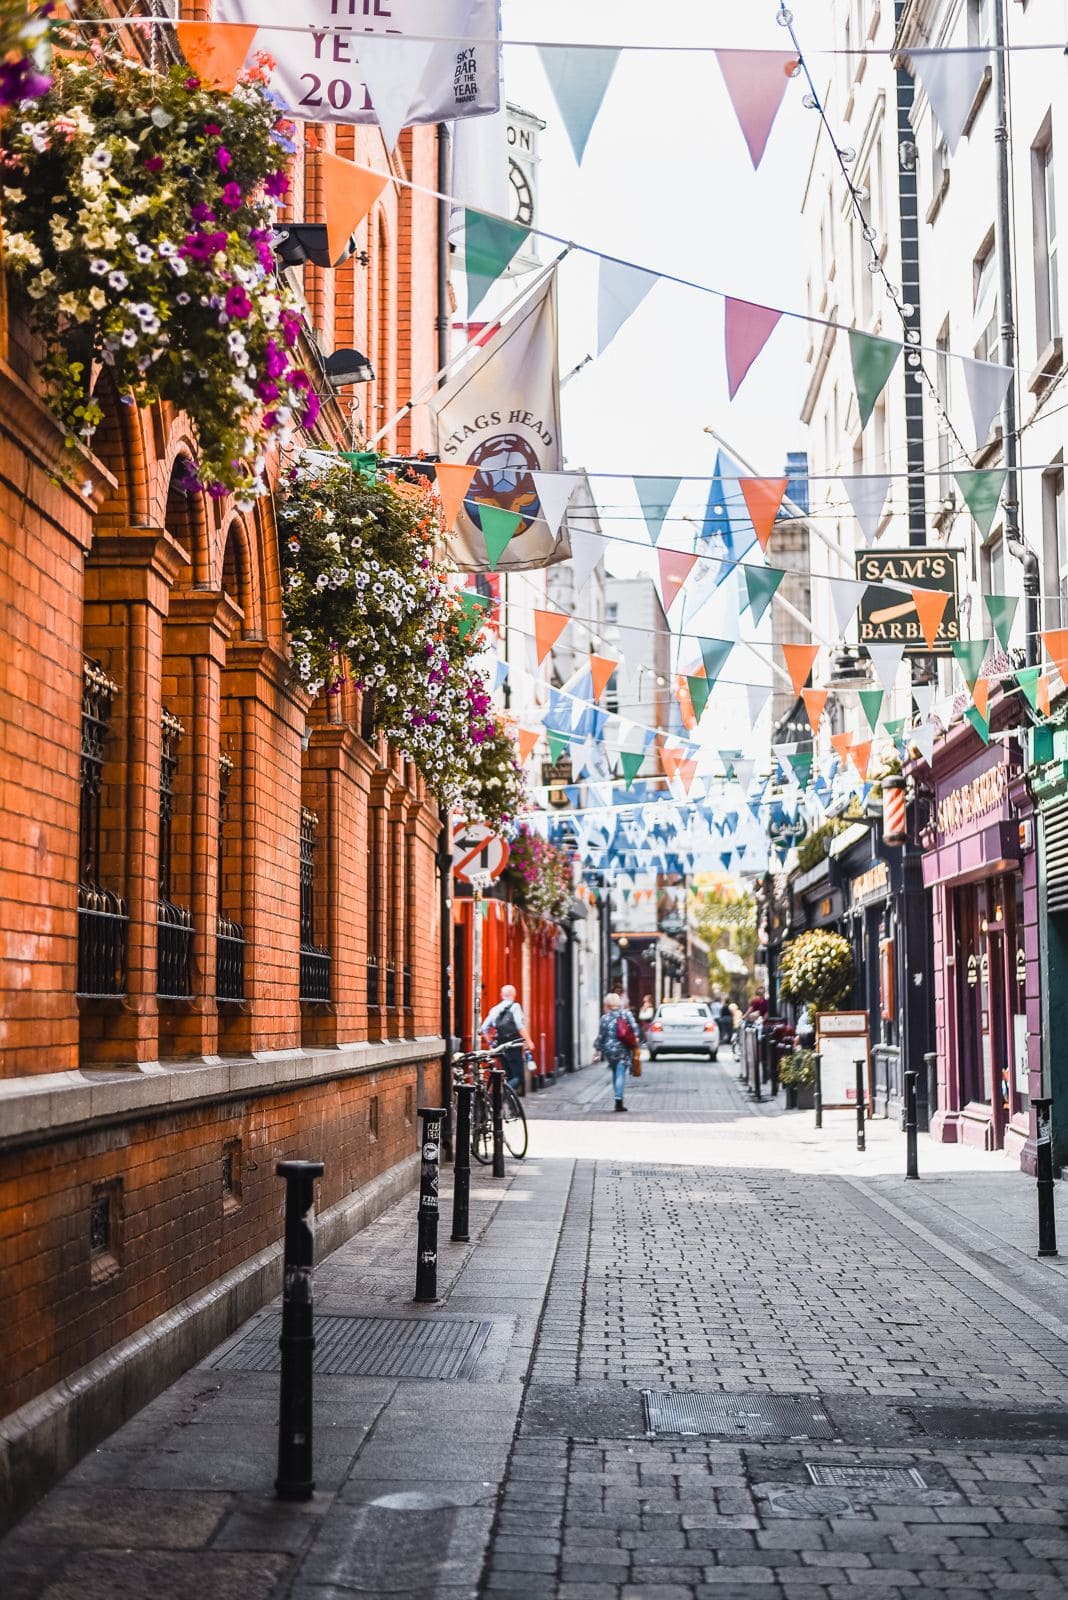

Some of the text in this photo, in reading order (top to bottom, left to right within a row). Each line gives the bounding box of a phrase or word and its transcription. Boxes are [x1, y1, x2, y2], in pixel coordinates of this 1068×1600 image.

[308, 24, 402, 64] YE
[456, 46, 475, 64] SKY
[455, 59, 477, 77] BAR
[464, 73, 476, 82] THE
[298, 73, 375, 110] 201
[453, 82, 477, 96] YEAR
[443, 409, 553, 455] STAGS HEAD
[865, 557, 946, 579] SAM'S
